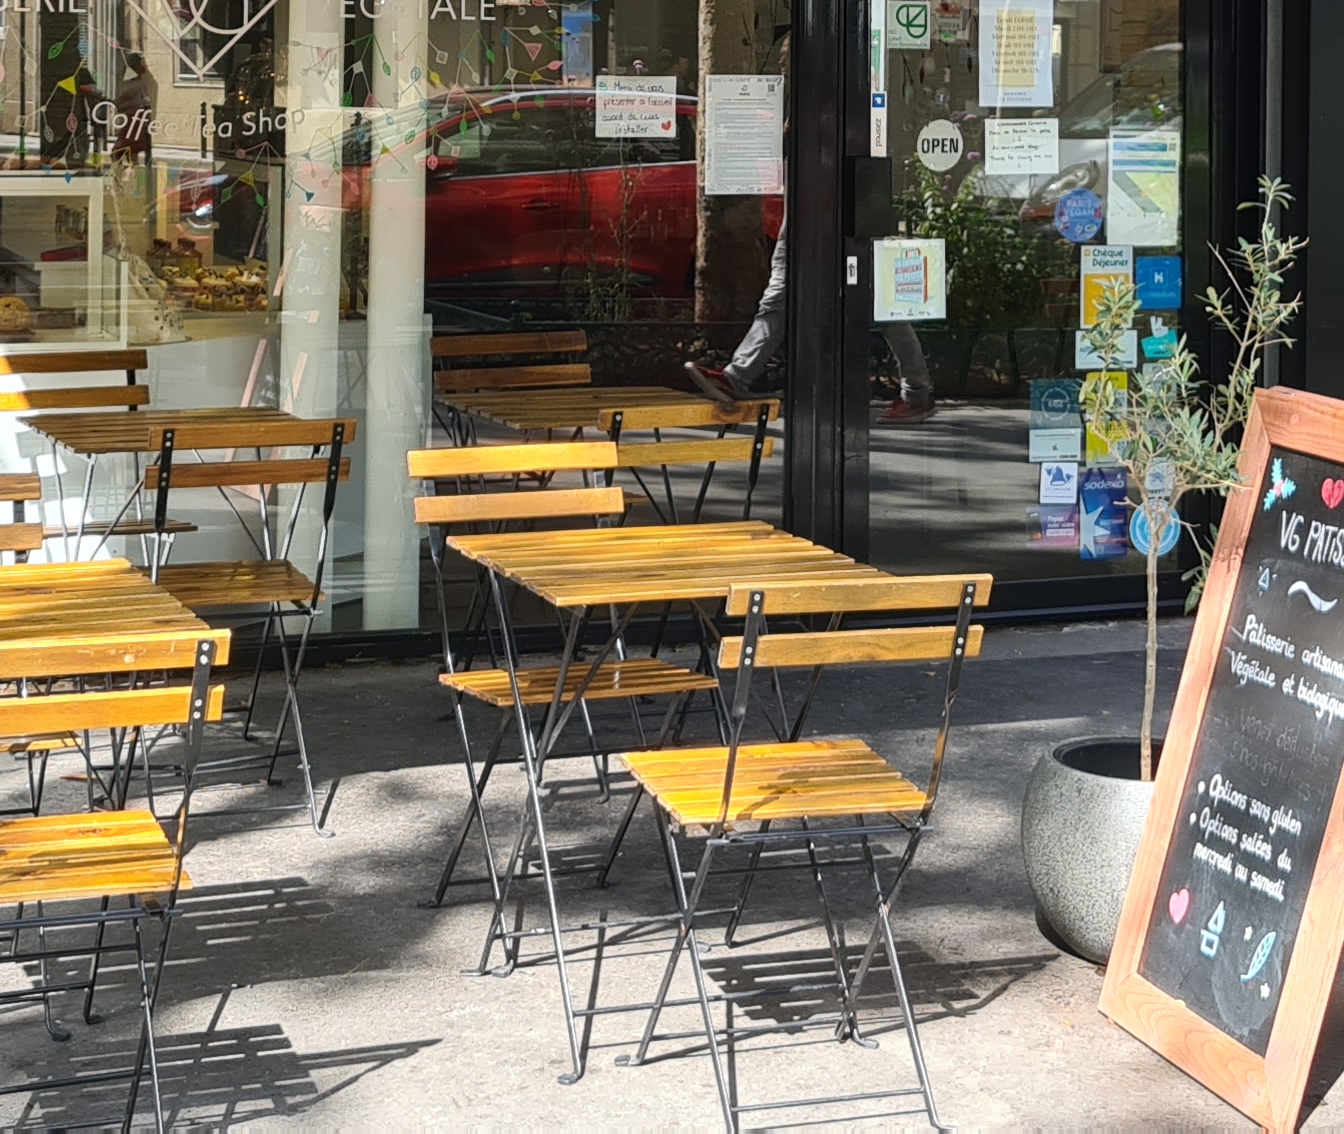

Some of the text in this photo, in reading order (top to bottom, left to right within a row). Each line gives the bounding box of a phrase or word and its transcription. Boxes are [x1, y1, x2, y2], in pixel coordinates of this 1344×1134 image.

[92, 100, 306, 142] Coffee Tea Shop
[921, 137, 960, 154] OPEN
[1063, 207, 1095, 217] VEGAN
[1066, 199, 1092, 208] PARIS
[1092, 248, 1124, 258] Chèque
[1092, 257, 1129, 268] Déjeuner
[1083, 479, 1125, 490] sodexo
[1280, 509, 1305, 554] VG
[1242, 613, 1296, 659] Pâtisserie
[1230, 649, 1277, 688] Végétale
[1281, 673, 1296, 695] et
[1209, 773, 1302, 837] Options sans gluten
[1199, 806, 1292, 873] Options salées du
[1193, 841, 1235, 875] mercredi
[1234, 863, 1249, 884] au
